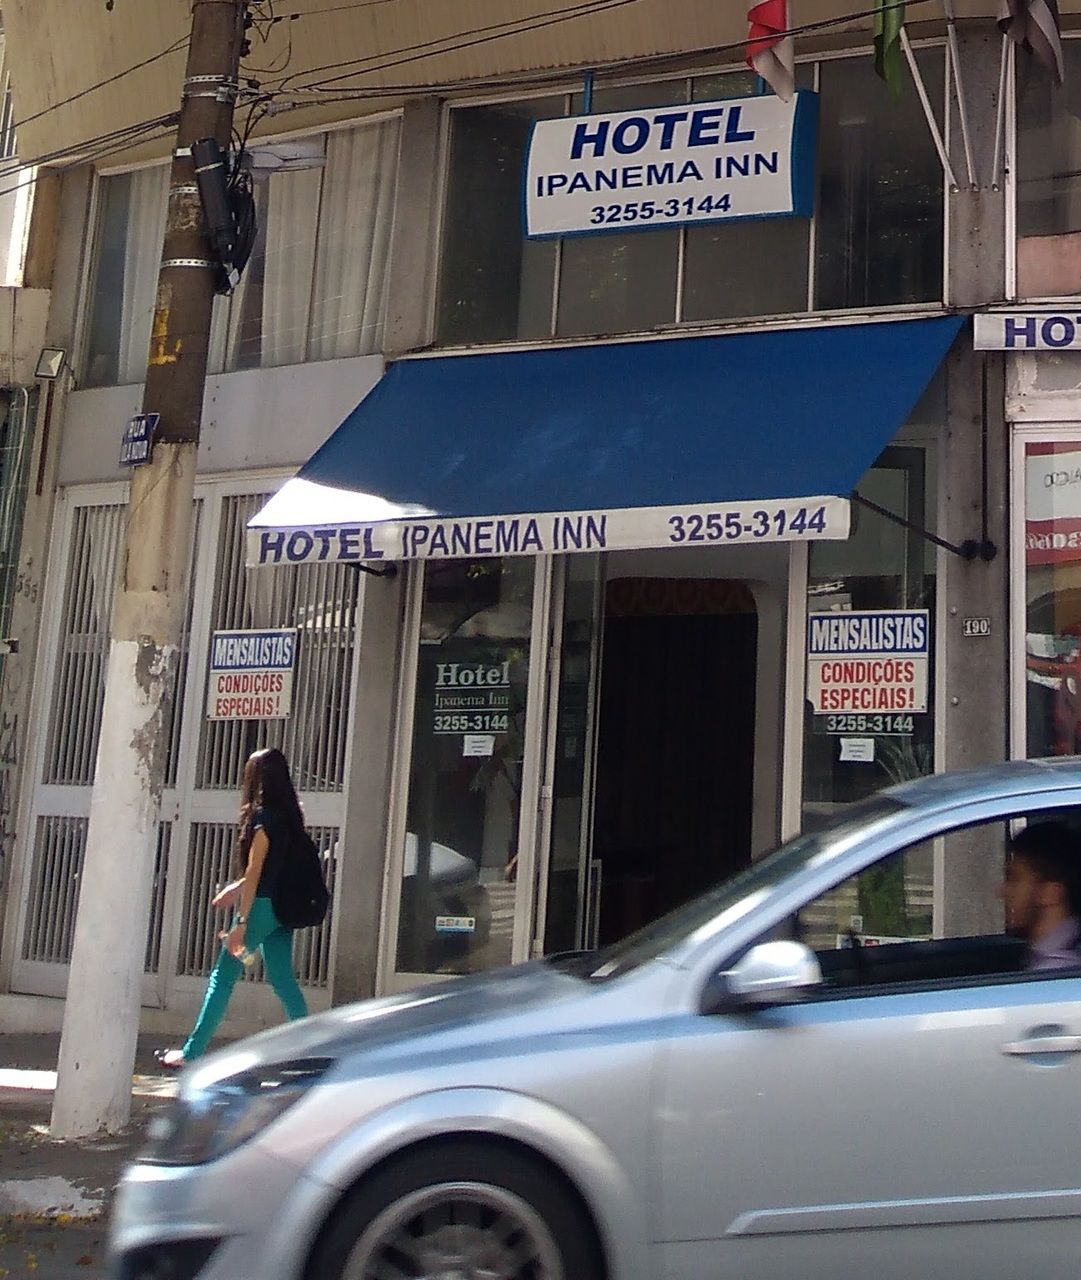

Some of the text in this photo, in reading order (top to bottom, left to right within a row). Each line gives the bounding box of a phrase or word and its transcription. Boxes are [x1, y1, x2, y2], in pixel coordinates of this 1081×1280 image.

[569, 106, 757, 160] HOTEL
[535, 150, 780, 198] IPANEMA INN
[589, 193, 732, 225] 3255-3144
[258, 505, 827, 565] HOTEL IPANEMA INN 3255-3144
[811, 616, 925, 651] MENSALISTAS
[965, 620, 989, 634] 190
[214, 636, 292, 666] MENSALISTAS
[434, 661, 511, 686] Hotel
[434, 691, 510, 709] Ipanema Inn
[820, 687, 915, 710] ESPECIAIS!
[433, 714, 509, 731] 3255-3144
[827, 715, 915, 732] 3255-3144
